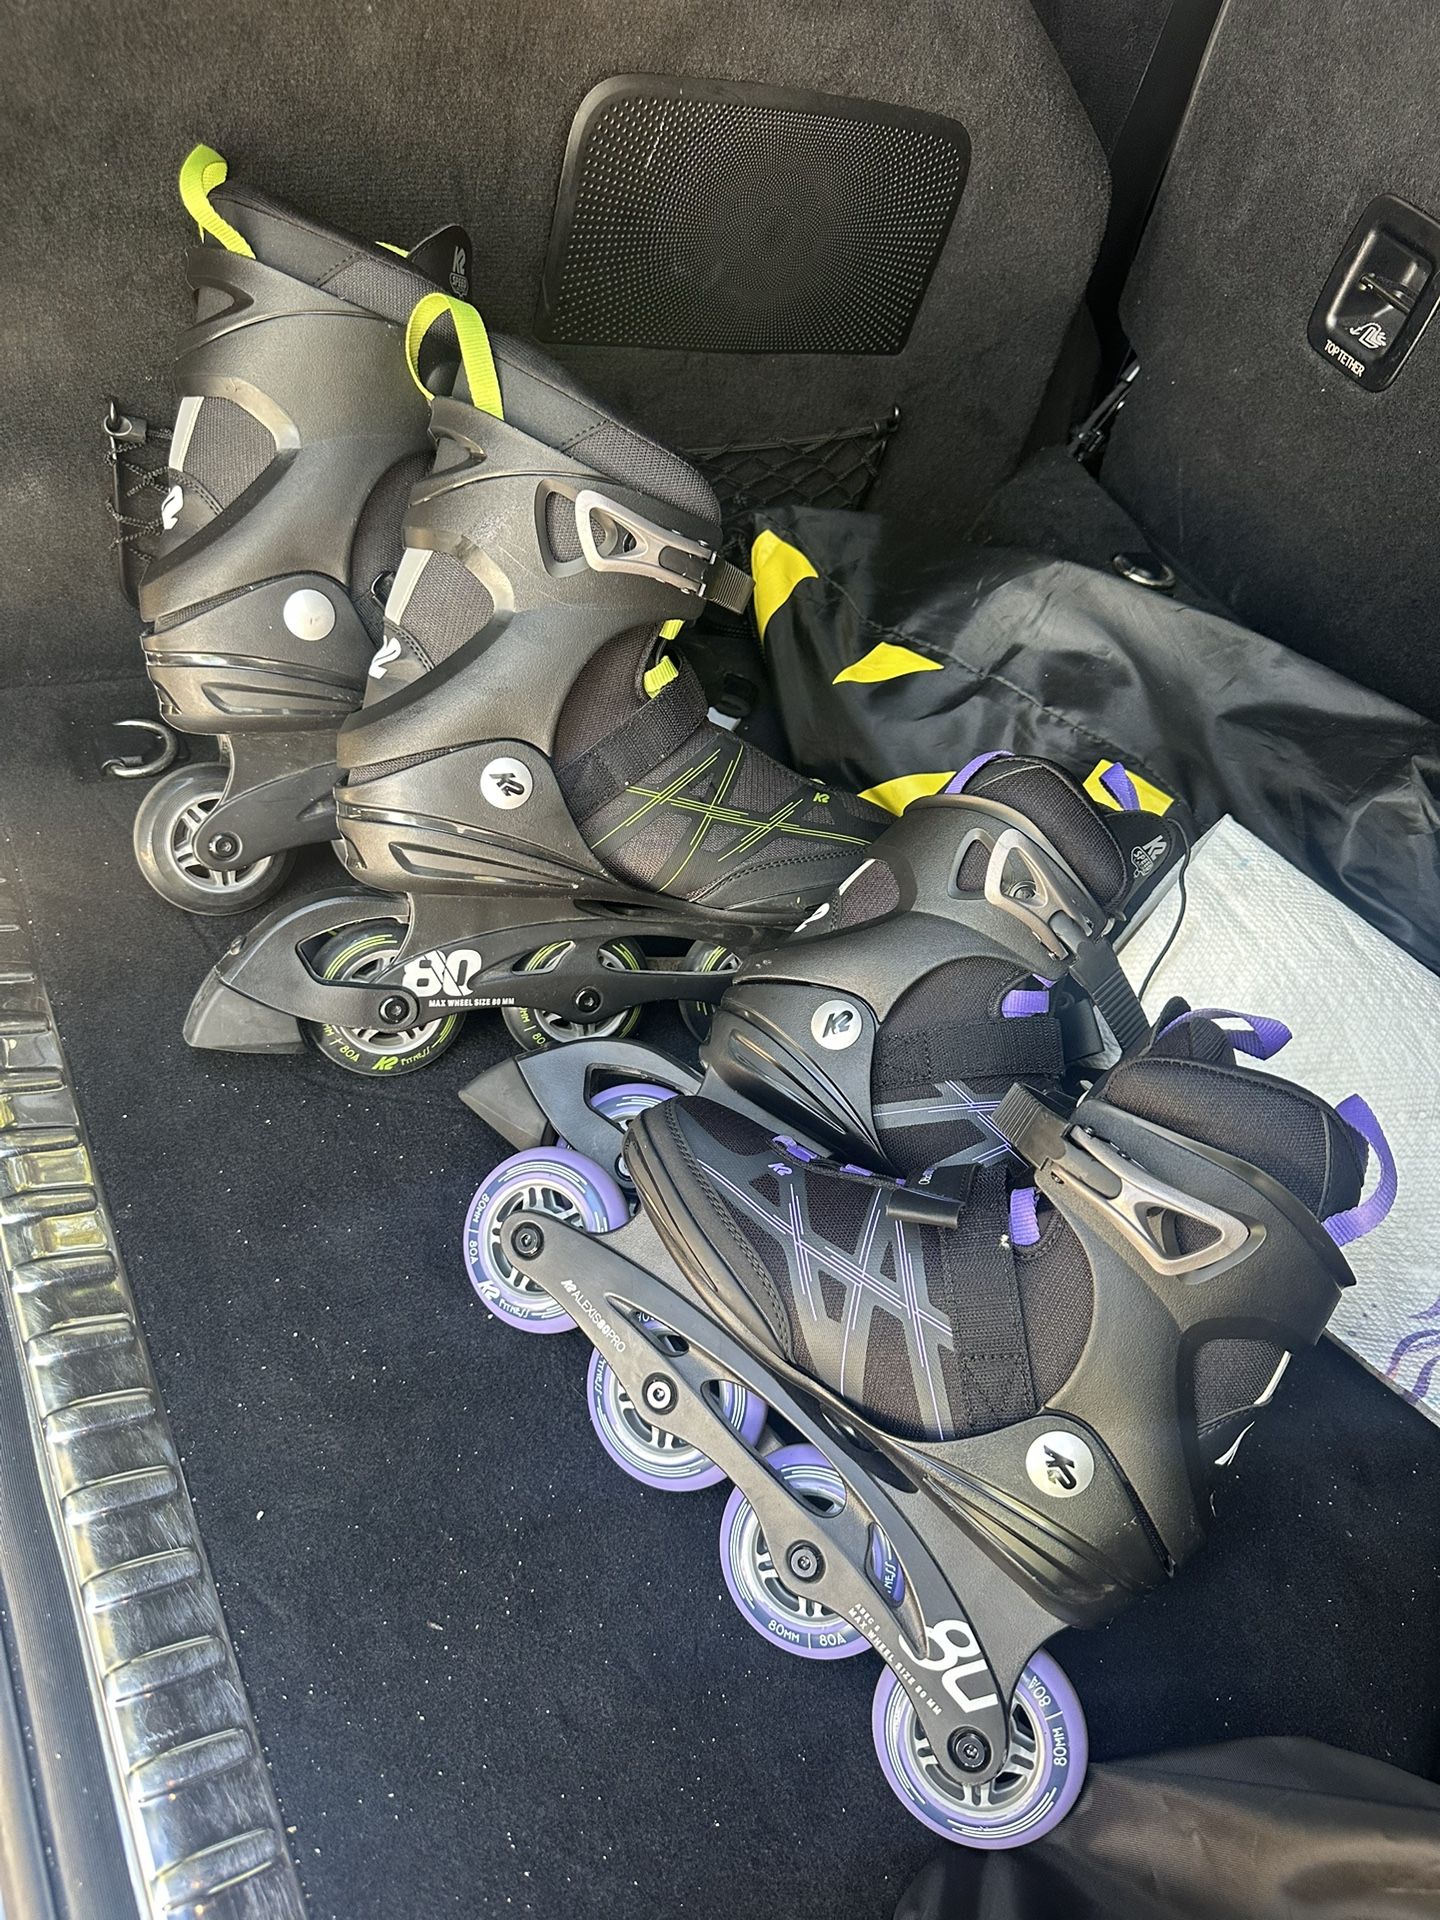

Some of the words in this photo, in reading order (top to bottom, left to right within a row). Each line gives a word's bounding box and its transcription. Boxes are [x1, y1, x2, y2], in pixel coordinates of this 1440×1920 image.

[452, 246, 466, 276] K2
[1324, 339, 1340, 357] TOP
[1337, 349, 1366, 378] TETHER
[489, 773, 525, 797] K2
[812, 792, 830, 803] K2
[1142, 834, 1167, 861] K2
[402, 949, 483, 997] 80
[428, 999, 447, 1008] MAX
[447, 998, 474, 1007] WHEEL
[474, 998, 491, 1007] SIZE
[491, 998, 501, 1006] 80
[502, 997, 515, 1005] MM
[822, 1010, 854, 1039] K2
[532, 1032, 546, 1045] 80
[339, 1045, 361, 1062] 80A
[371, 1055, 399, 1071] K2
[768, 1162, 793, 1176] K2
[472, 1193, 490, 1223] 80MM
[469, 1240, 479, 1265] 80A
[477, 1279, 501, 1301] K2
[560, 1279, 577, 1293] K2
[1043, 1444, 1078, 1491] K2
[768, 1620, 801, 1644] 80MM
[819, 1633, 848, 1648] 80A
[848, 1607, 868, 1631] MAX
[867, 1629, 896, 1663] WHEEL
[894, 1662, 916, 1686] SIZE
[914, 1684, 928, 1700] 80
[925, 1698, 943, 1716] MM
[1027, 1675, 1053, 1708] 80A
[1052, 1726, 1068, 1767] 80MM
